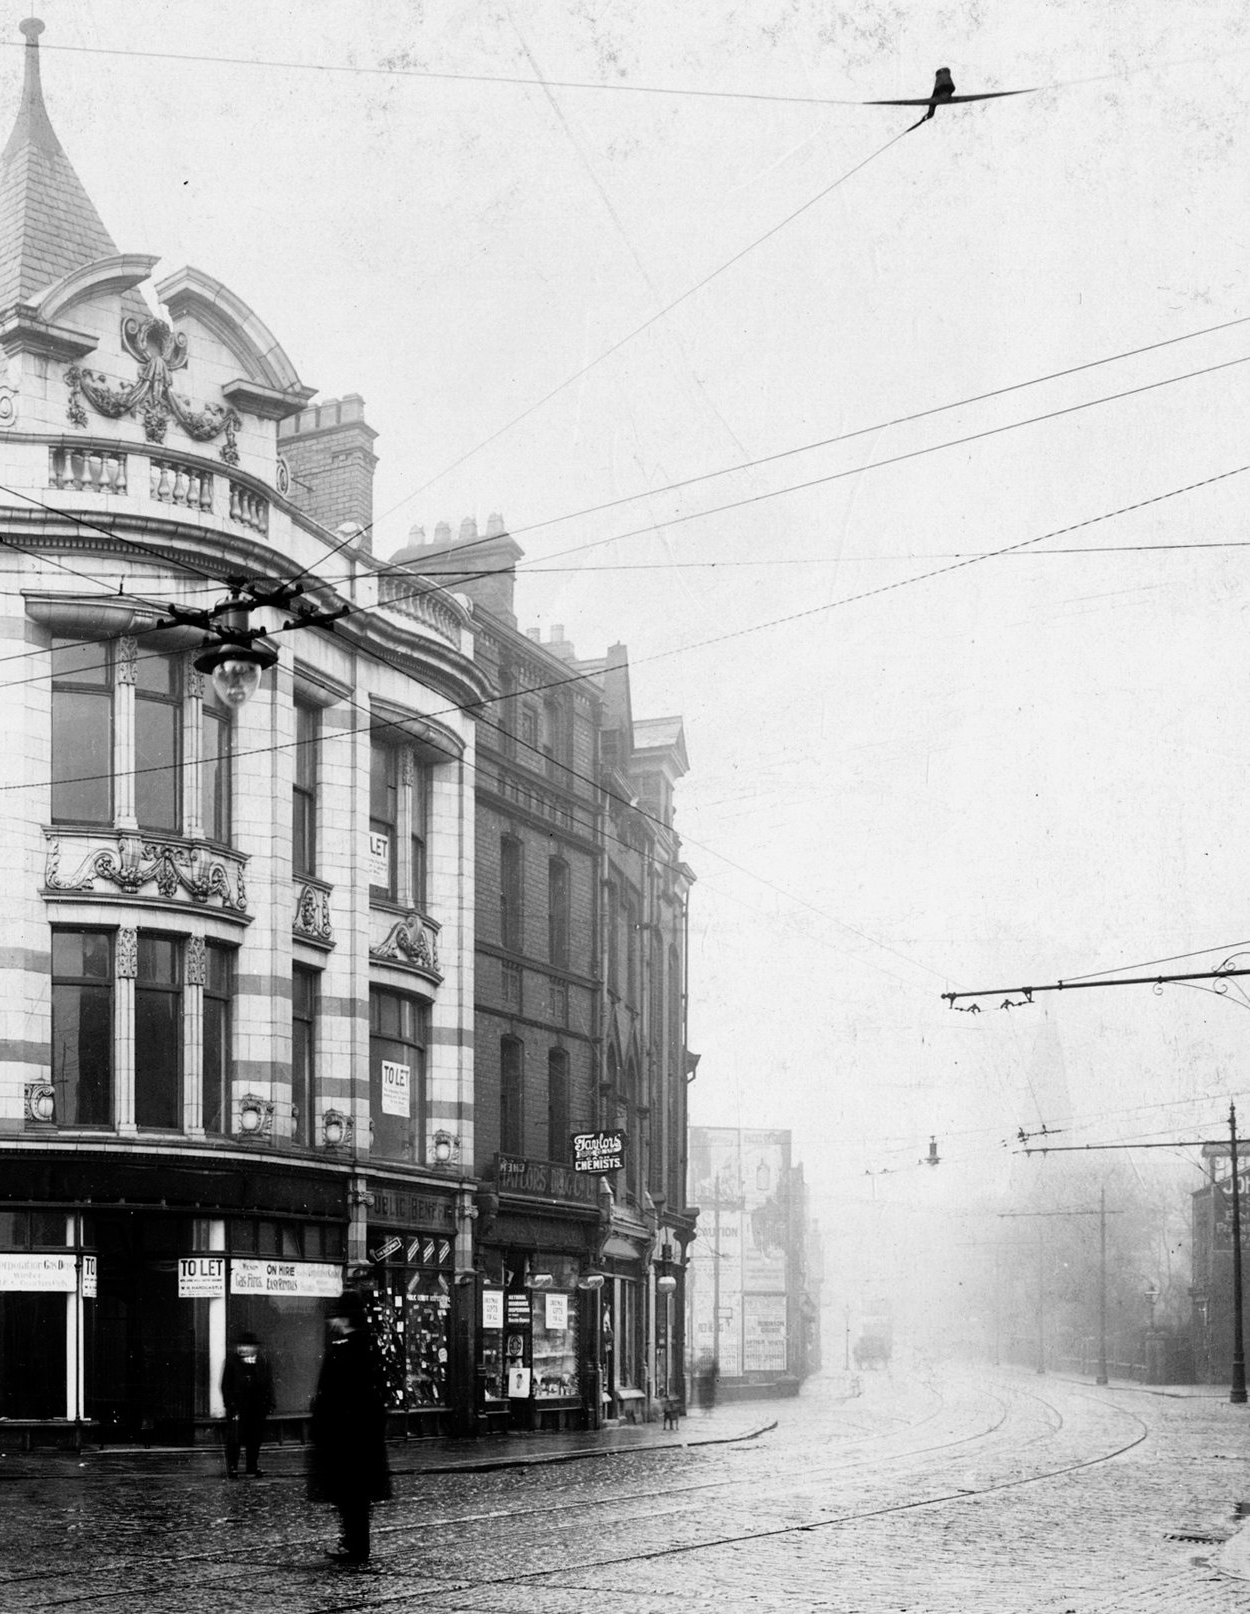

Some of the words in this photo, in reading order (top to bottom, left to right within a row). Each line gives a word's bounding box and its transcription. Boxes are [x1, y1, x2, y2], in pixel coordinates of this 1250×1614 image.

[370, 835, 388, 858] LET
[384, 1066, 394, 1084] TO
[396, 1068, 409, 1087] LET
[375, 1196, 405, 1217] UBLIC
[43, 1259, 57, 1270] Gas
[180, 1259, 197, 1276] TO
[200, 1259, 223, 1276] LET
[266, 1264, 277, 1276] ON
[279, 1265, 295, 1277] HIRE
